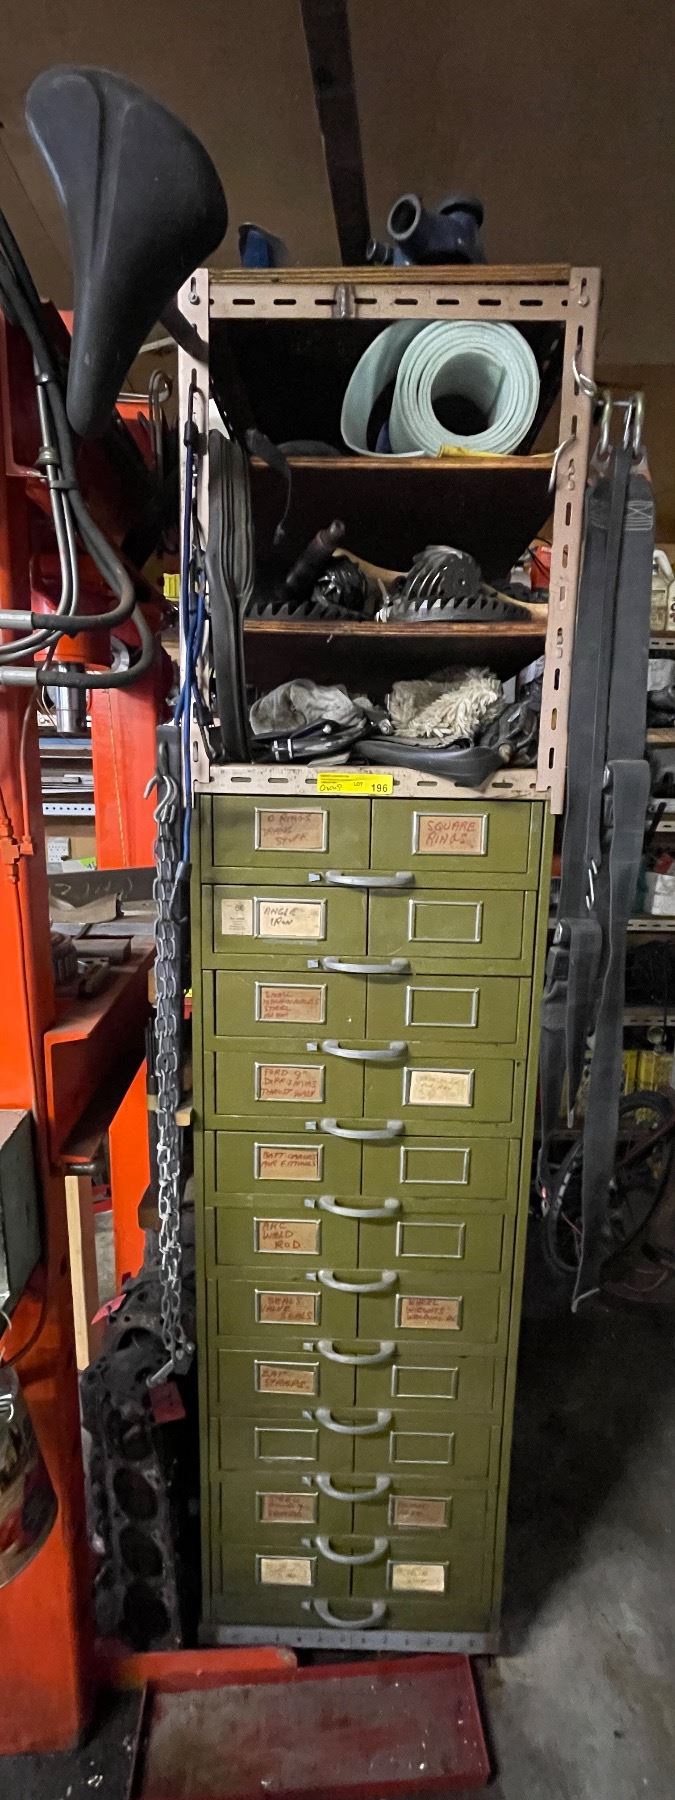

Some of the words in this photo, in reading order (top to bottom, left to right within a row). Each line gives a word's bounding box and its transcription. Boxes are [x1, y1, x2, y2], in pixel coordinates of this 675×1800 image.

[371, 783, 388, 793] 196
[427, 820, 476, 833] SQUARE
[263, 906, 299, 916] ANGLE
[264, 1068, 289, 1077] FORD
[274, 1239, 303, 1249] ROD
